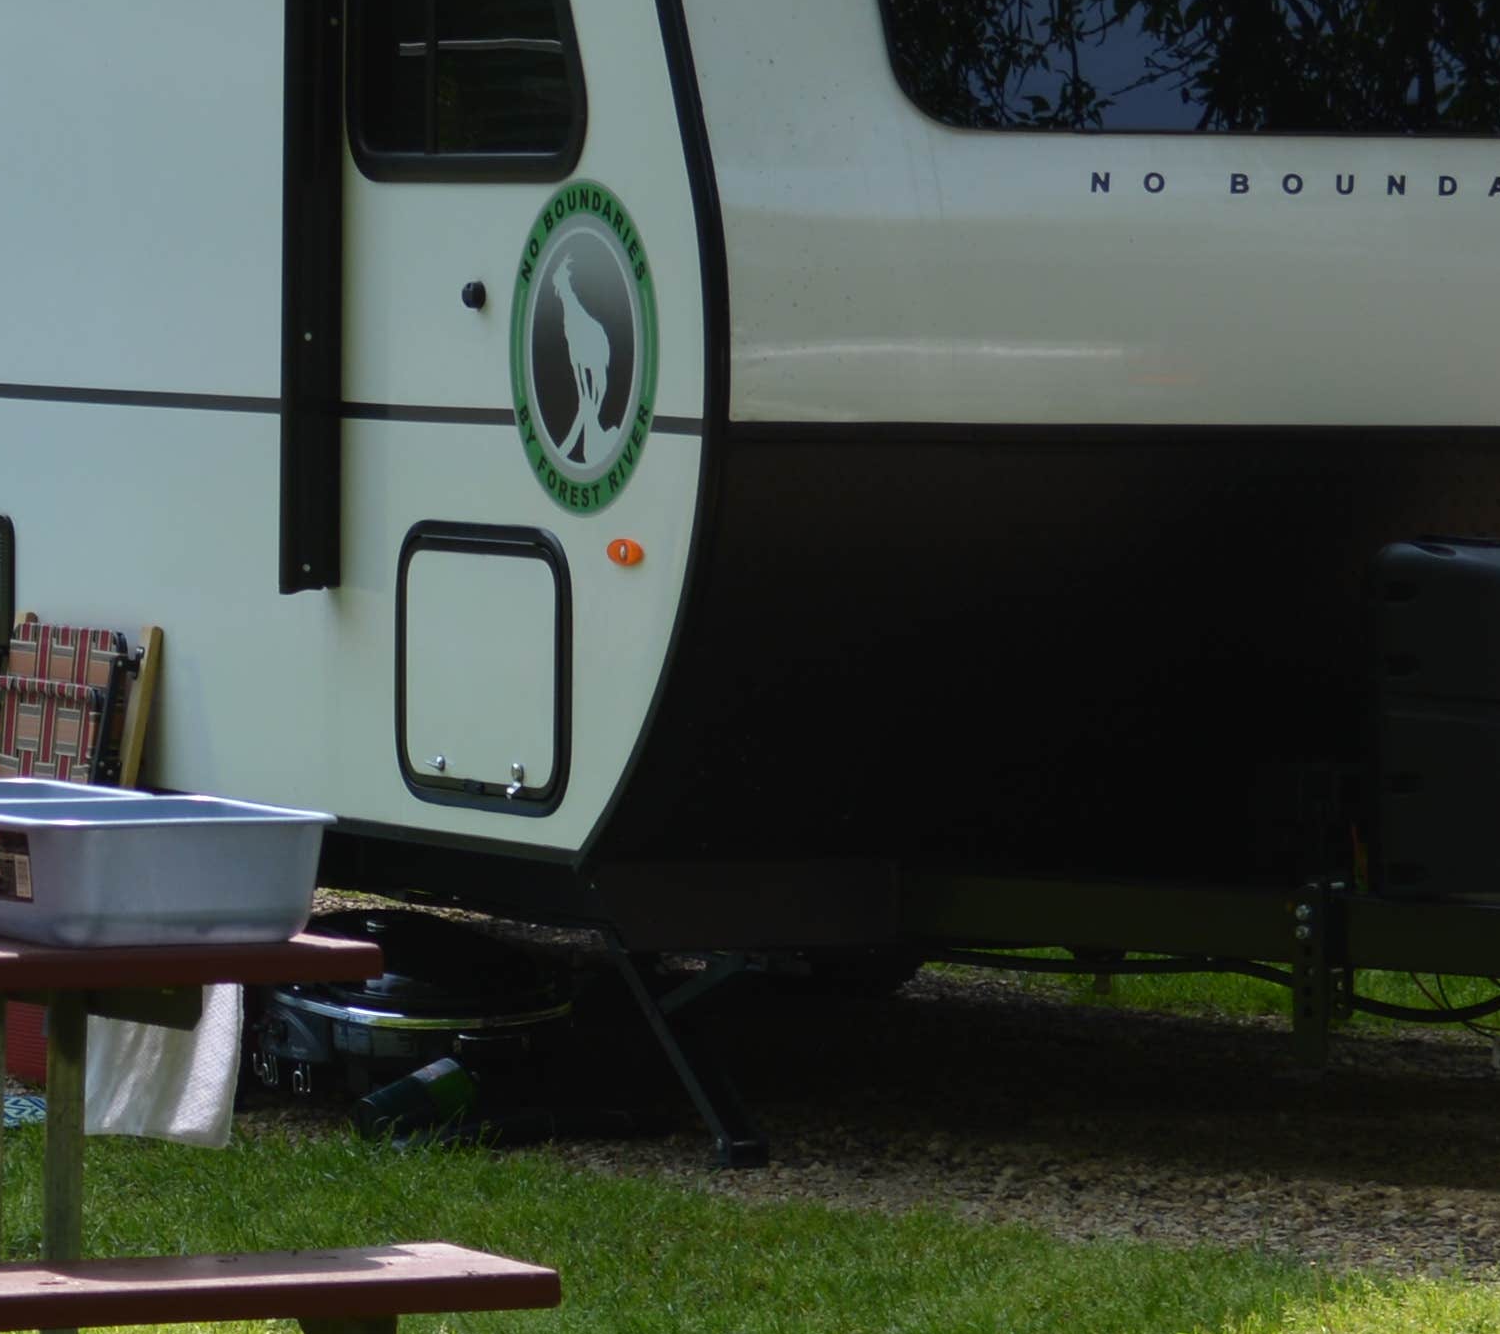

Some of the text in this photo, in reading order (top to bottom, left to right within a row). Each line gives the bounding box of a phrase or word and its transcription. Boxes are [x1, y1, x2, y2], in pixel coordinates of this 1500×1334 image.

[1090, 172, 1166, 195] NO
[521, 187, 646, 283] NO BOUNDARIES
[519, 403, 650, 508] BY FOREST RIVER
